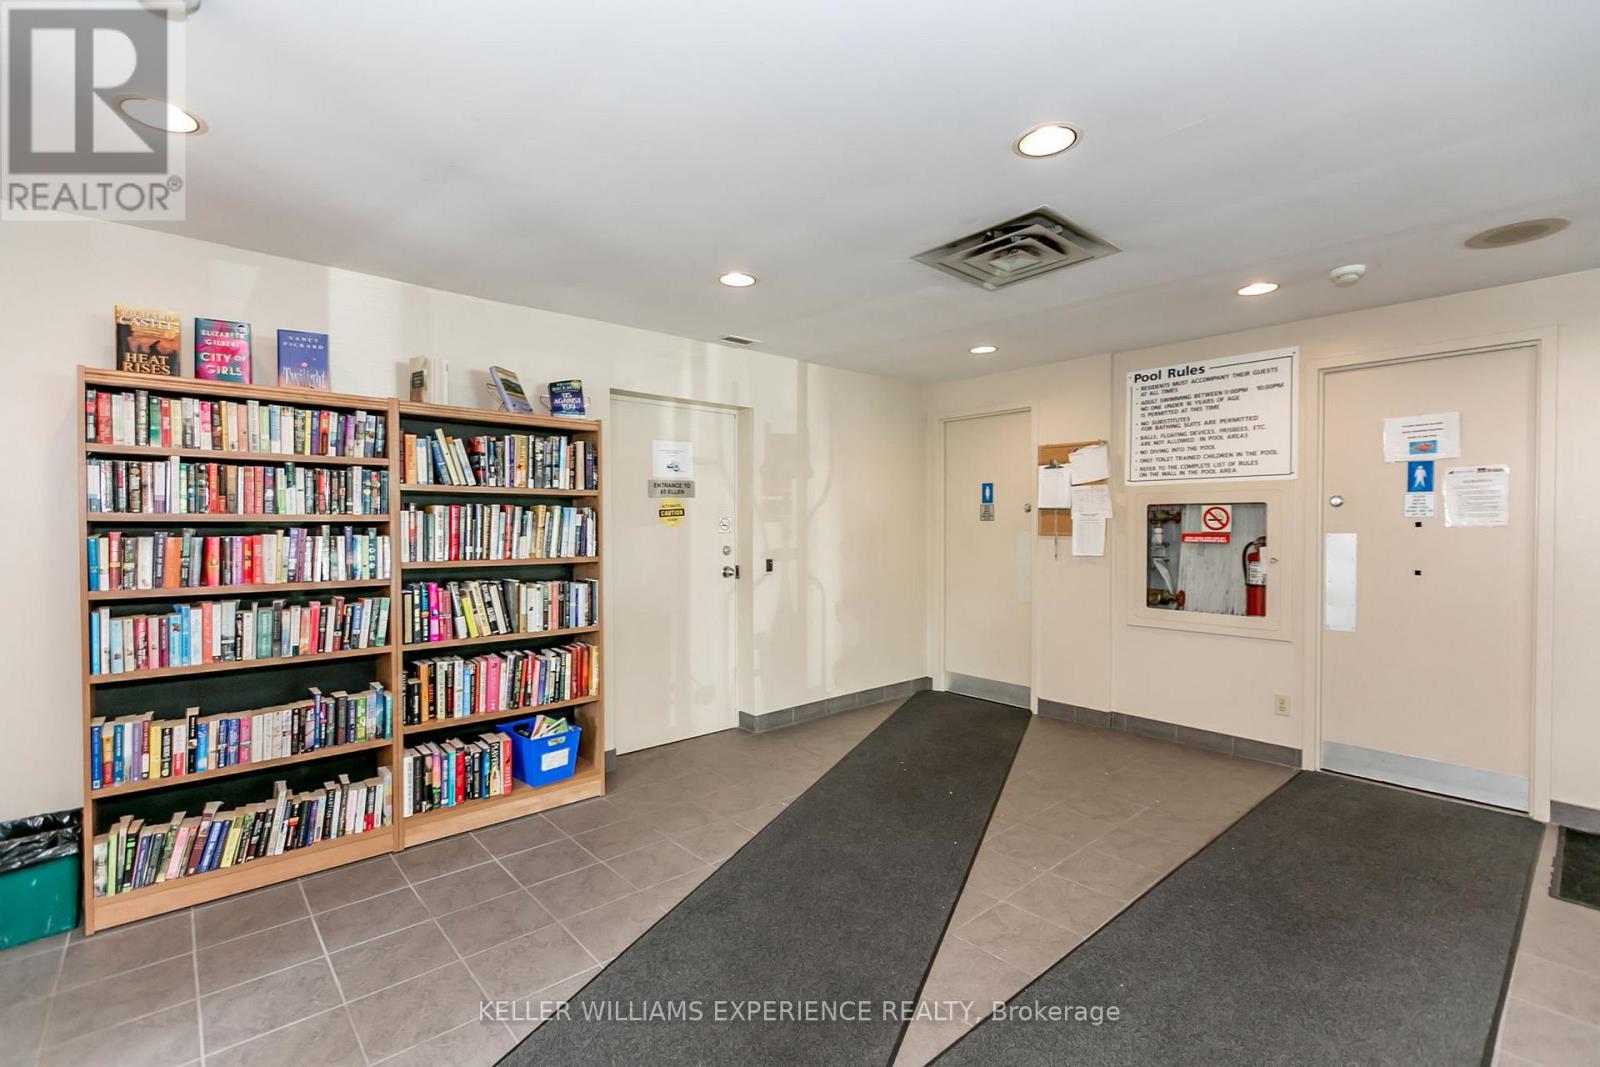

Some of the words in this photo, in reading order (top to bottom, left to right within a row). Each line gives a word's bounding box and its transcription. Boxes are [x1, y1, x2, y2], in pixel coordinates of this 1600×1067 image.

[206, 339, 241, 348] GILBERT
[125, 352, 169, 365] HEAT
[201, 352, 231, 362] CITY
[123, 361, 171, 375] RISES
[206, 364, 243, 376] GIRLS
[1134, 370, 1161, 383] Pool
[1168, 365, 1205, 378] Rules
[1191, 374, 1229, 384] ACCOMPANY
[1253, 367, 1278, 375] GUESTS
[1160, 394, 1191, 403] SWIMMING
[1152, 417, 1190, 425] SUBSTITUTES
[1220, 416, 1259, 424] PERMITTED
